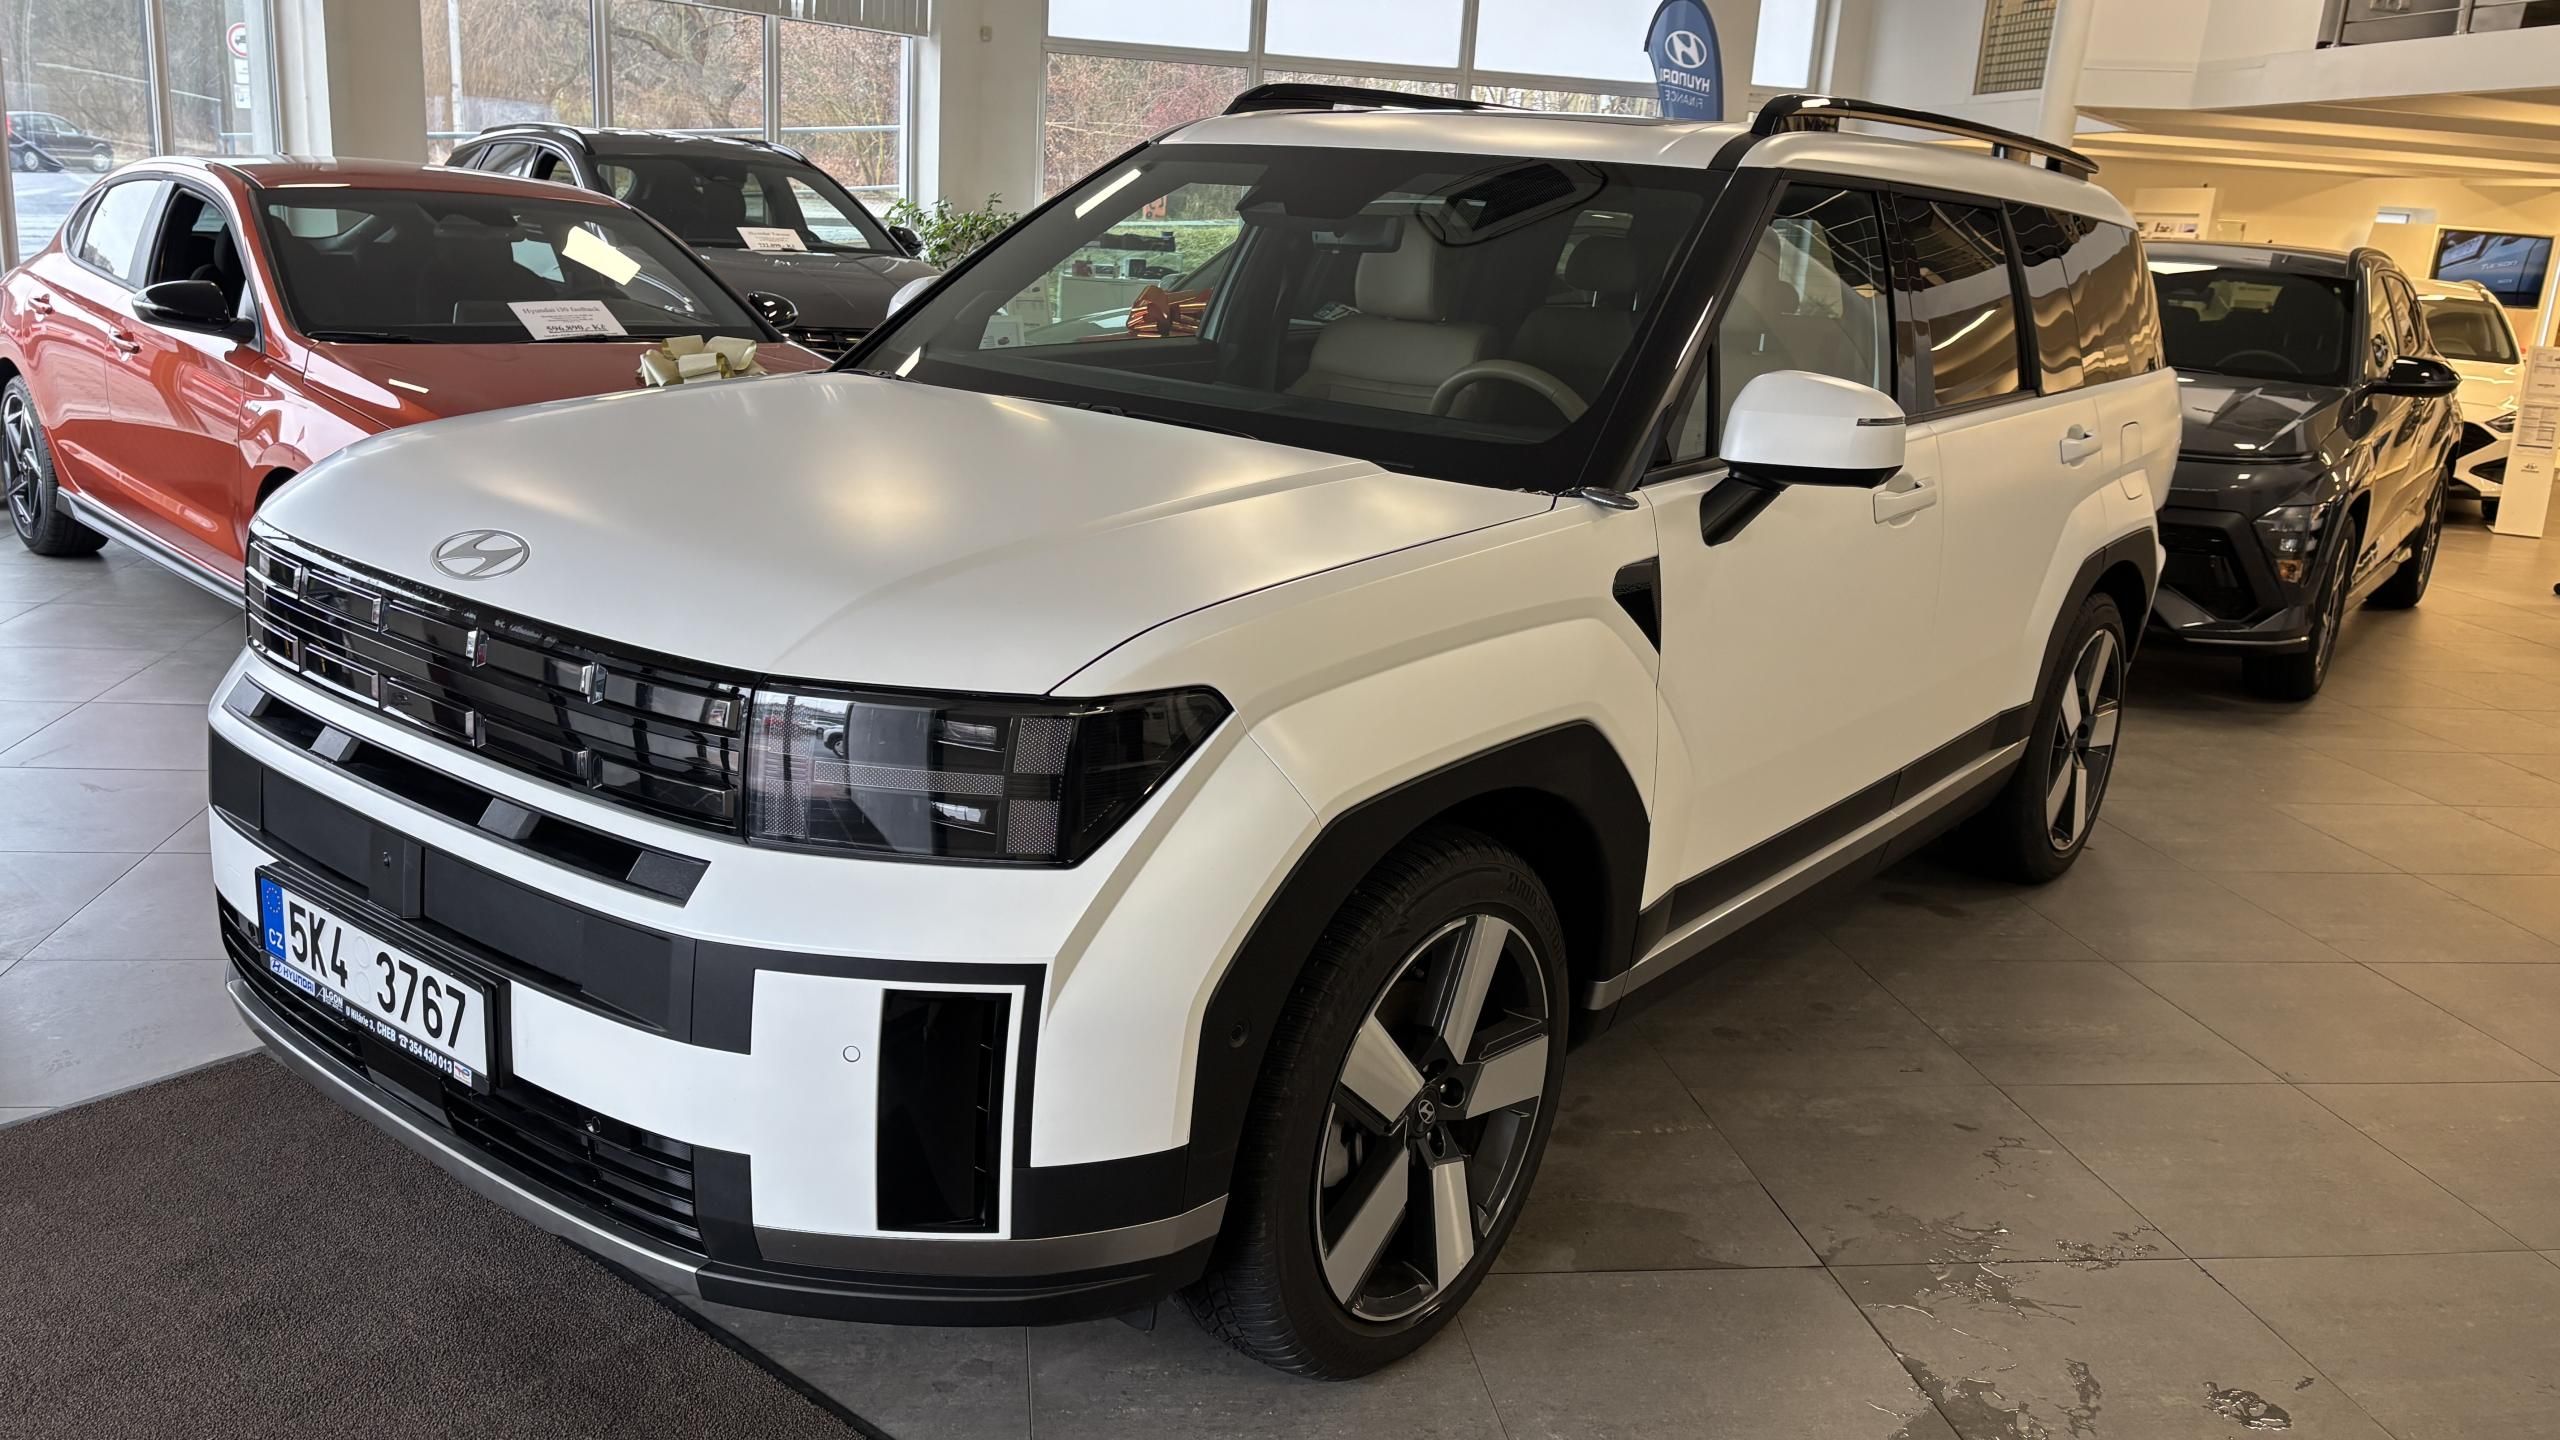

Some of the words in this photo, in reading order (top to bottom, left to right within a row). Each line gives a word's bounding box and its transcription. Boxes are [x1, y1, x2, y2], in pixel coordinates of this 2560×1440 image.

[268, 927, 283, 950] CZ
[283, 966, 314, 993] HYUNDAI
[289, 901, 348, 989] 5K4
[376, 951, 466, 1049] 3767
[376, 1020, 396, 1042] CHEB
[408, 1040, 422, 1058] 354
[423, 1048, 437, 1066] 430
[438, 1056, 453, 1074] 013
